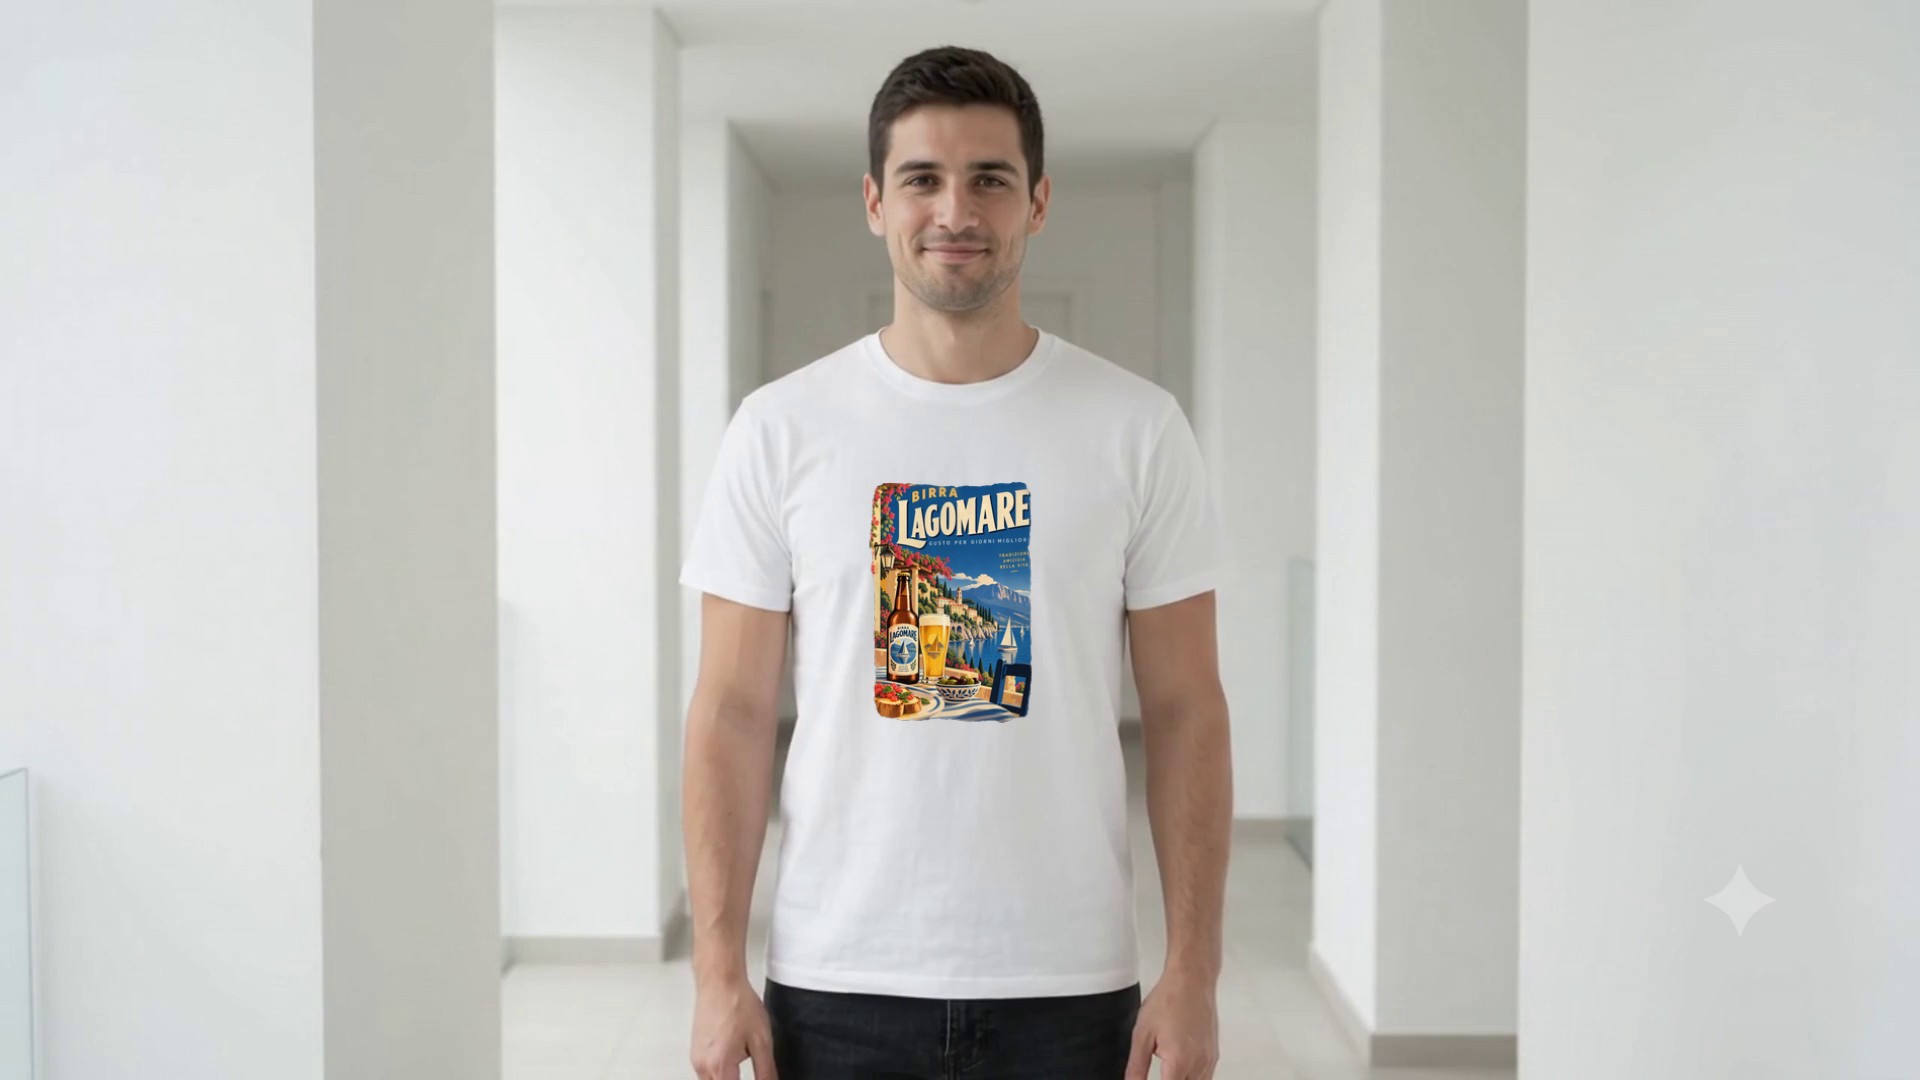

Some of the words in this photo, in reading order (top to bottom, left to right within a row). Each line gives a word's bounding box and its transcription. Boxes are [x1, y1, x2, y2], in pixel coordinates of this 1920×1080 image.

[912, 487, 958, 503] BIRRA
[896, 489, 1030, 549] LAGOMARE
[890, 629, 917, 643] LAGOMARE
